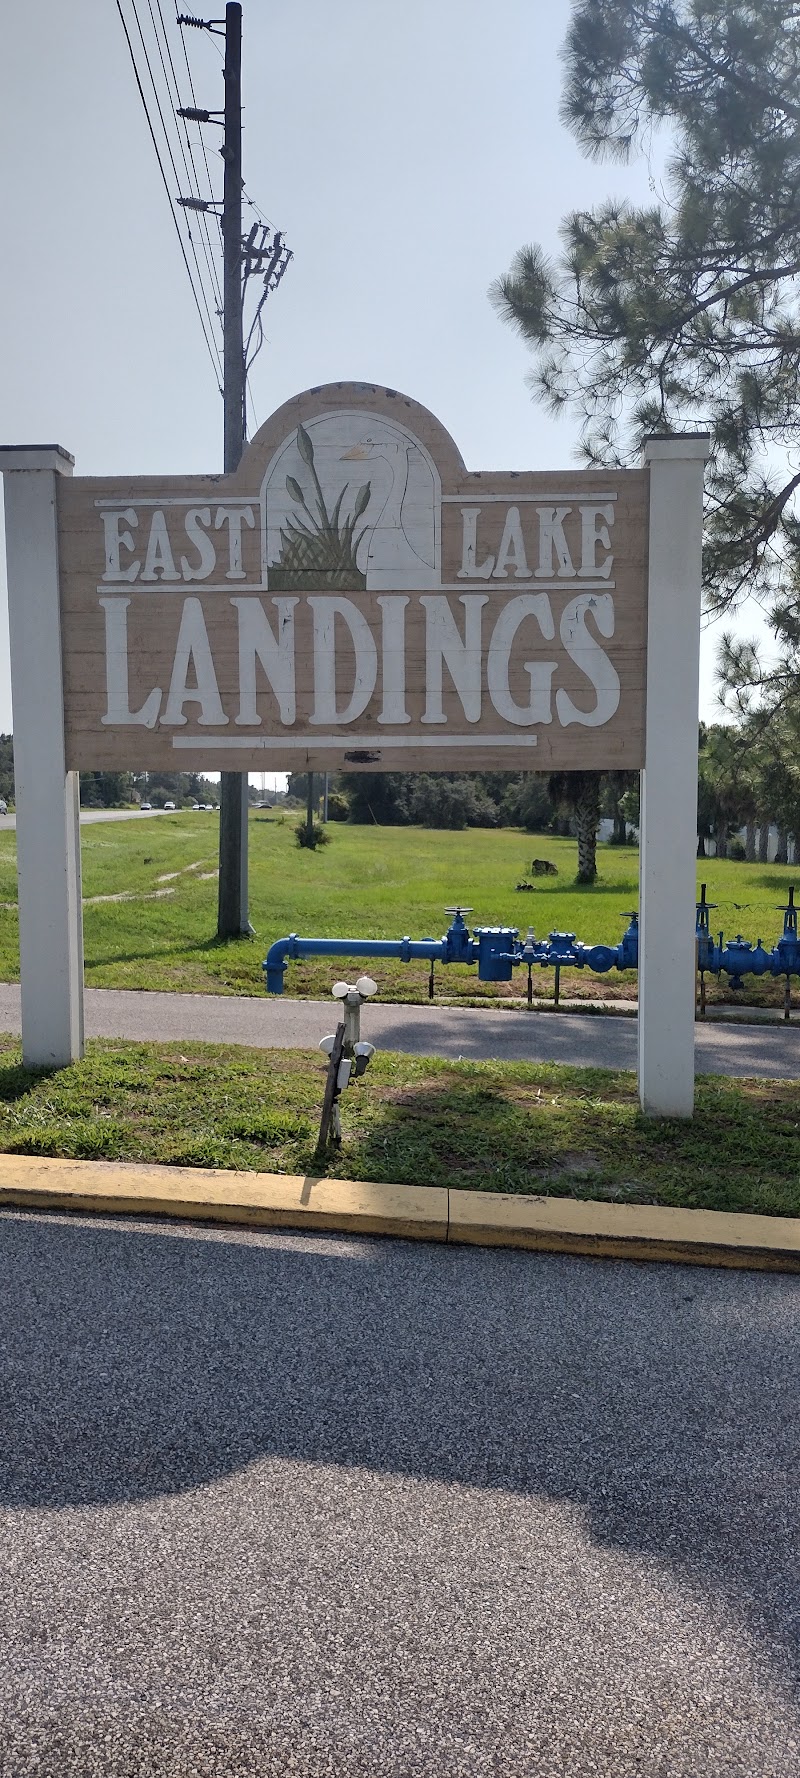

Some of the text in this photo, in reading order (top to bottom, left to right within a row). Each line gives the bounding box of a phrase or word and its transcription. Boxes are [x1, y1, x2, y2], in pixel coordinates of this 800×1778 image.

[100, 504, 615, 582] EAST LAKE
[99, 593, 621, 729] LANDINGS
